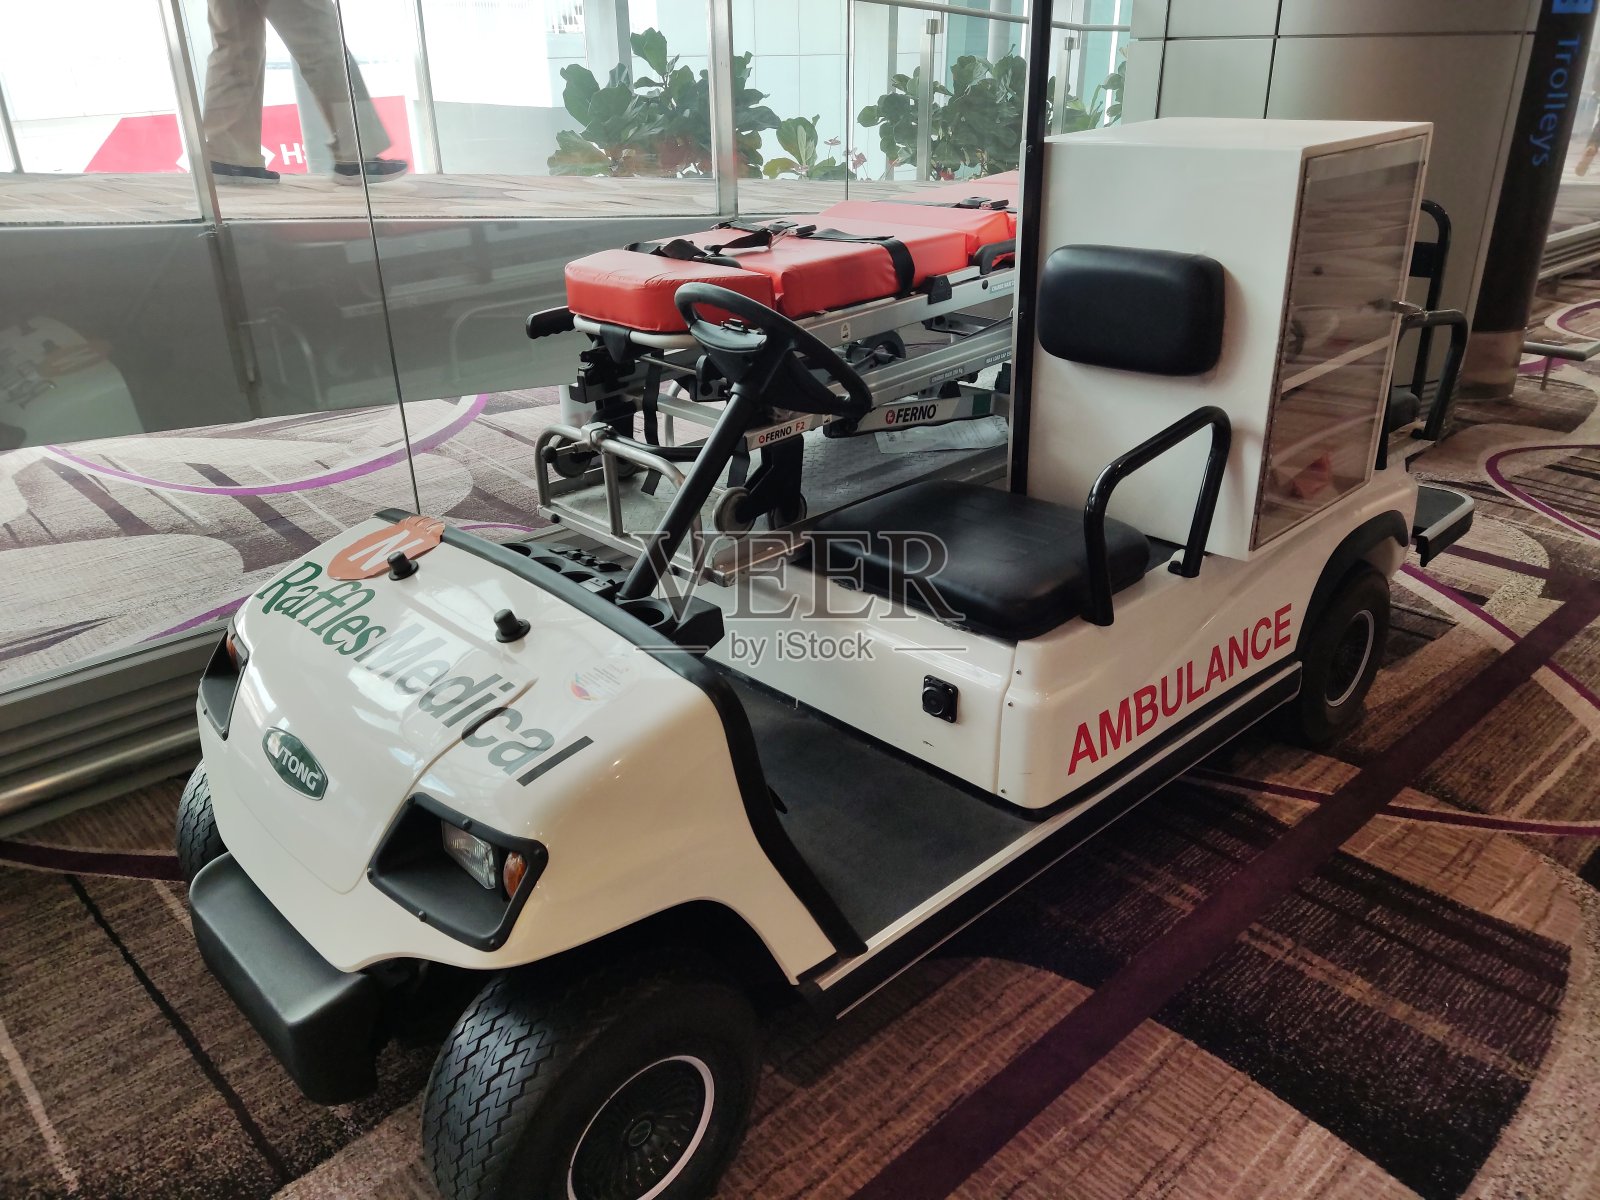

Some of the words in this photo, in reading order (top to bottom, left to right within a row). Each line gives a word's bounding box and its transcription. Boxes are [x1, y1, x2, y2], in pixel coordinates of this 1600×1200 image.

[1529, 34, 1581, 166] Trolleys
[765, 426, 792, 443] FERNO
[795, 421, 805, 432] F2
[895, 404, 937, 423] FERNO
[255, 561, 387, 656] Raffles
[353, 622, 594, 787] Medical
[1067, 603, 1293, 776] AMBULANCE
